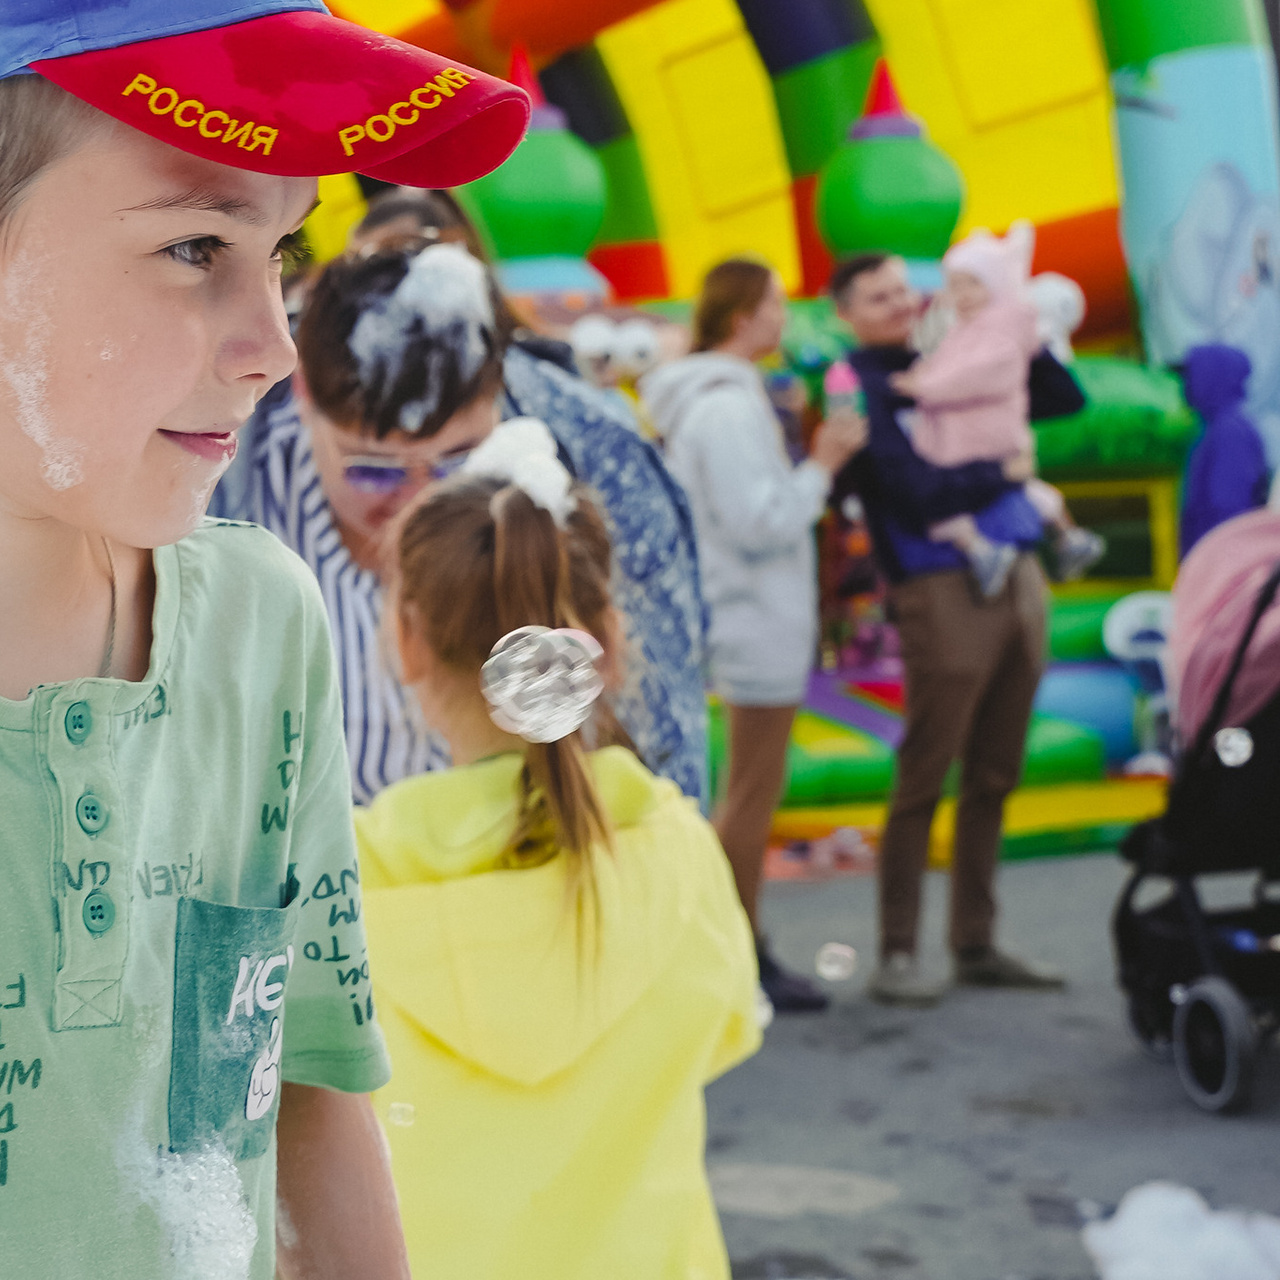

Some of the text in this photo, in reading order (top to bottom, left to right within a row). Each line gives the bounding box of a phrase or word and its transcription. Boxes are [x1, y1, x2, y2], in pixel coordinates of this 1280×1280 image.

[122, 66, 476, 157] РОССИЯ РОССИЯ
[302, 934, 351, 963] TO
